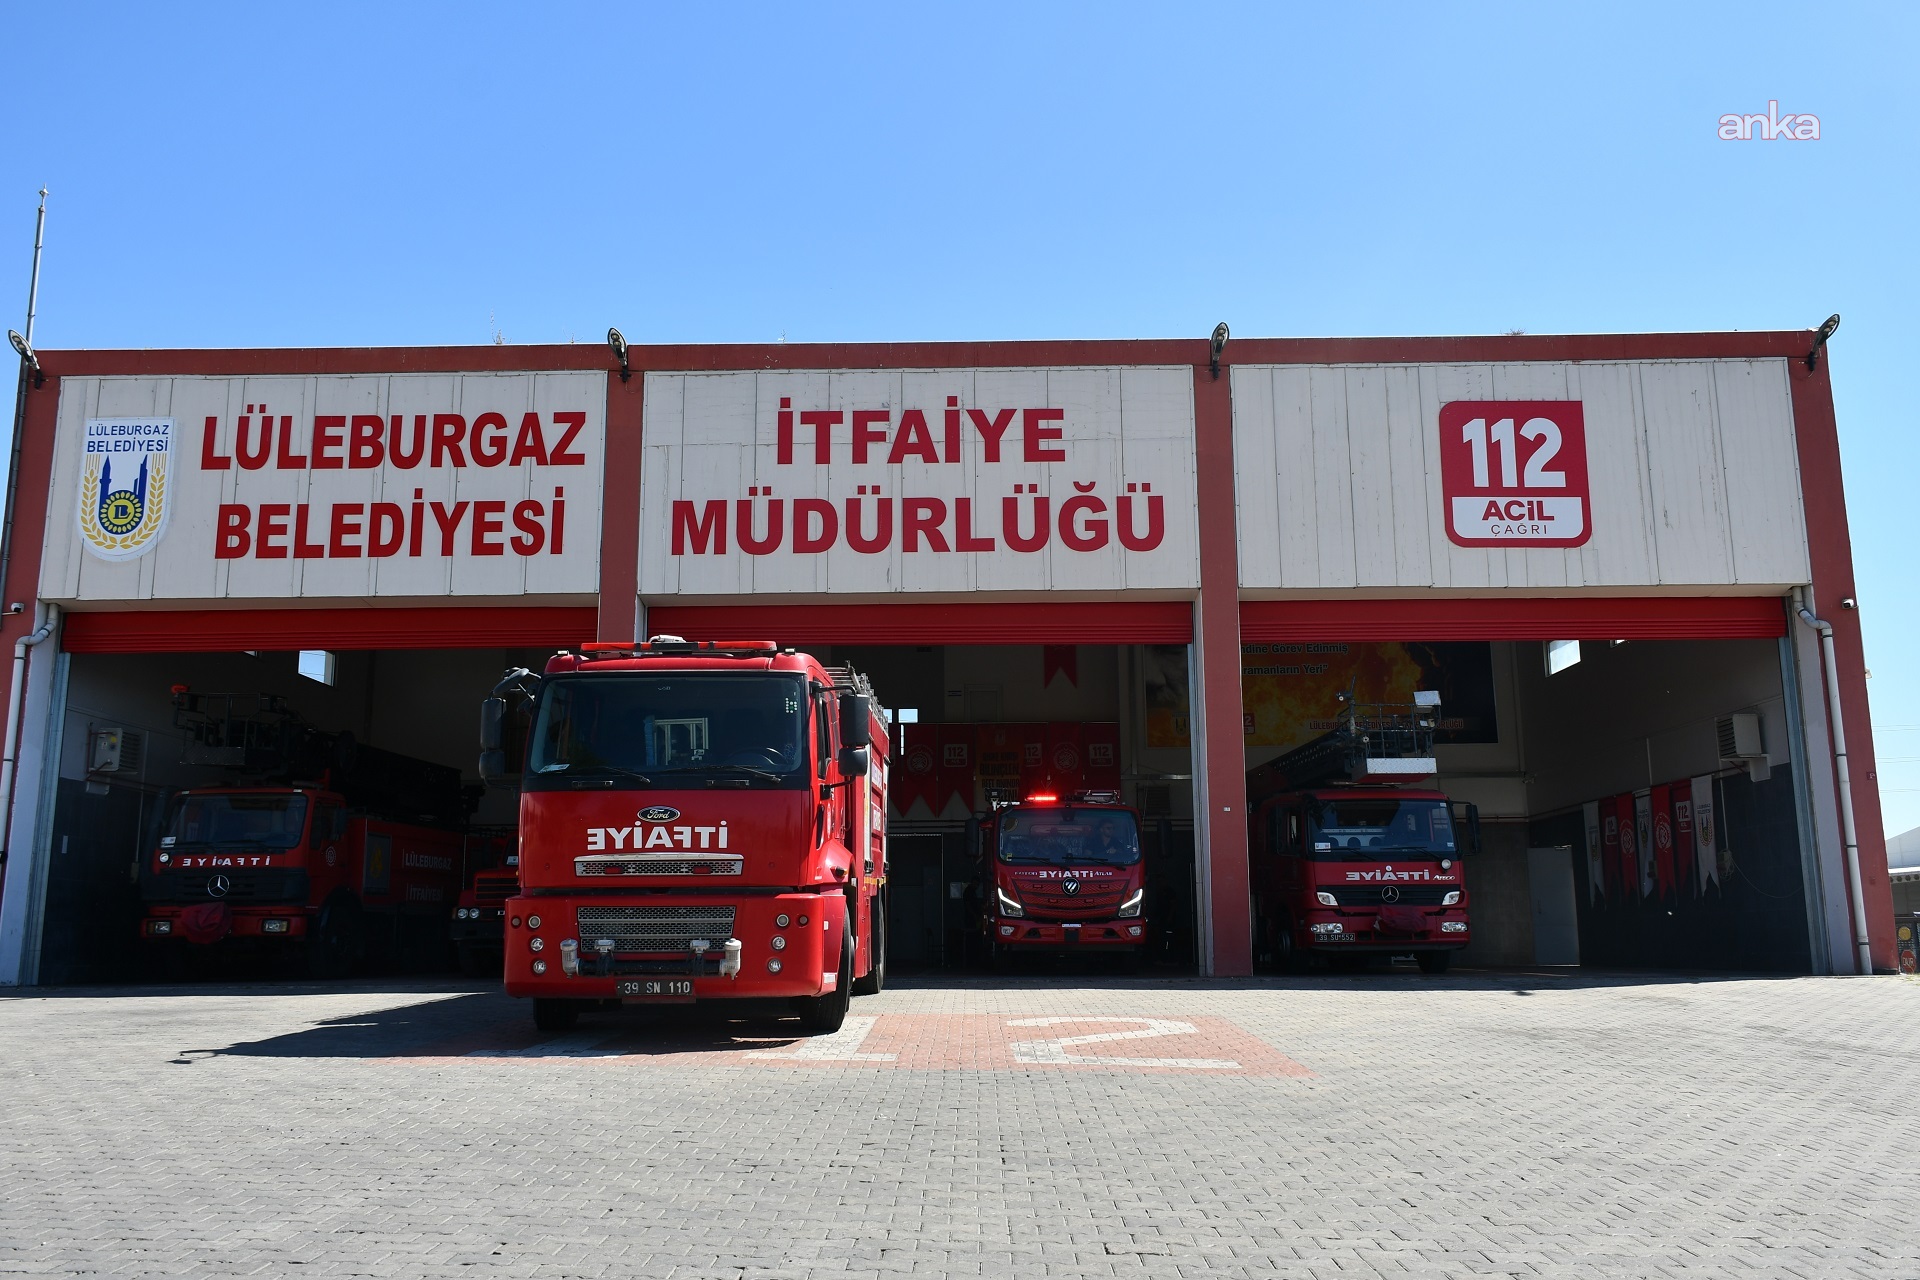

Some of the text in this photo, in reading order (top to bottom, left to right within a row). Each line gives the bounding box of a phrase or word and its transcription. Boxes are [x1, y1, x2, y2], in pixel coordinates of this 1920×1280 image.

[88, 424, 169, 436] LÜLEBURGAZ
[200, 404, 586, 470] LÜLEBURGAZ
[777, 395, 1066, 465] İTFAİYE
[87, 436, 169, 452] BELEDİYESİ
[1462, 417, 1567, 488] 112
[215, 486, 566, 560] BELEDİYESİ
[671, 481, 1165, 556] MÜDÜRLÜĞÜ
[1490, 523, 1548, 537] ÇAĞRI
[1240, 643, 1348, 655] ndine Görev Edinmiş
[1242, 666, 1300, 675] ramanların
[647, 808, 670, 819] Ford
[405, 851, 452, 871] LÜLEBURGAZ
[624, 981, 690, 994] 39 SN 110
